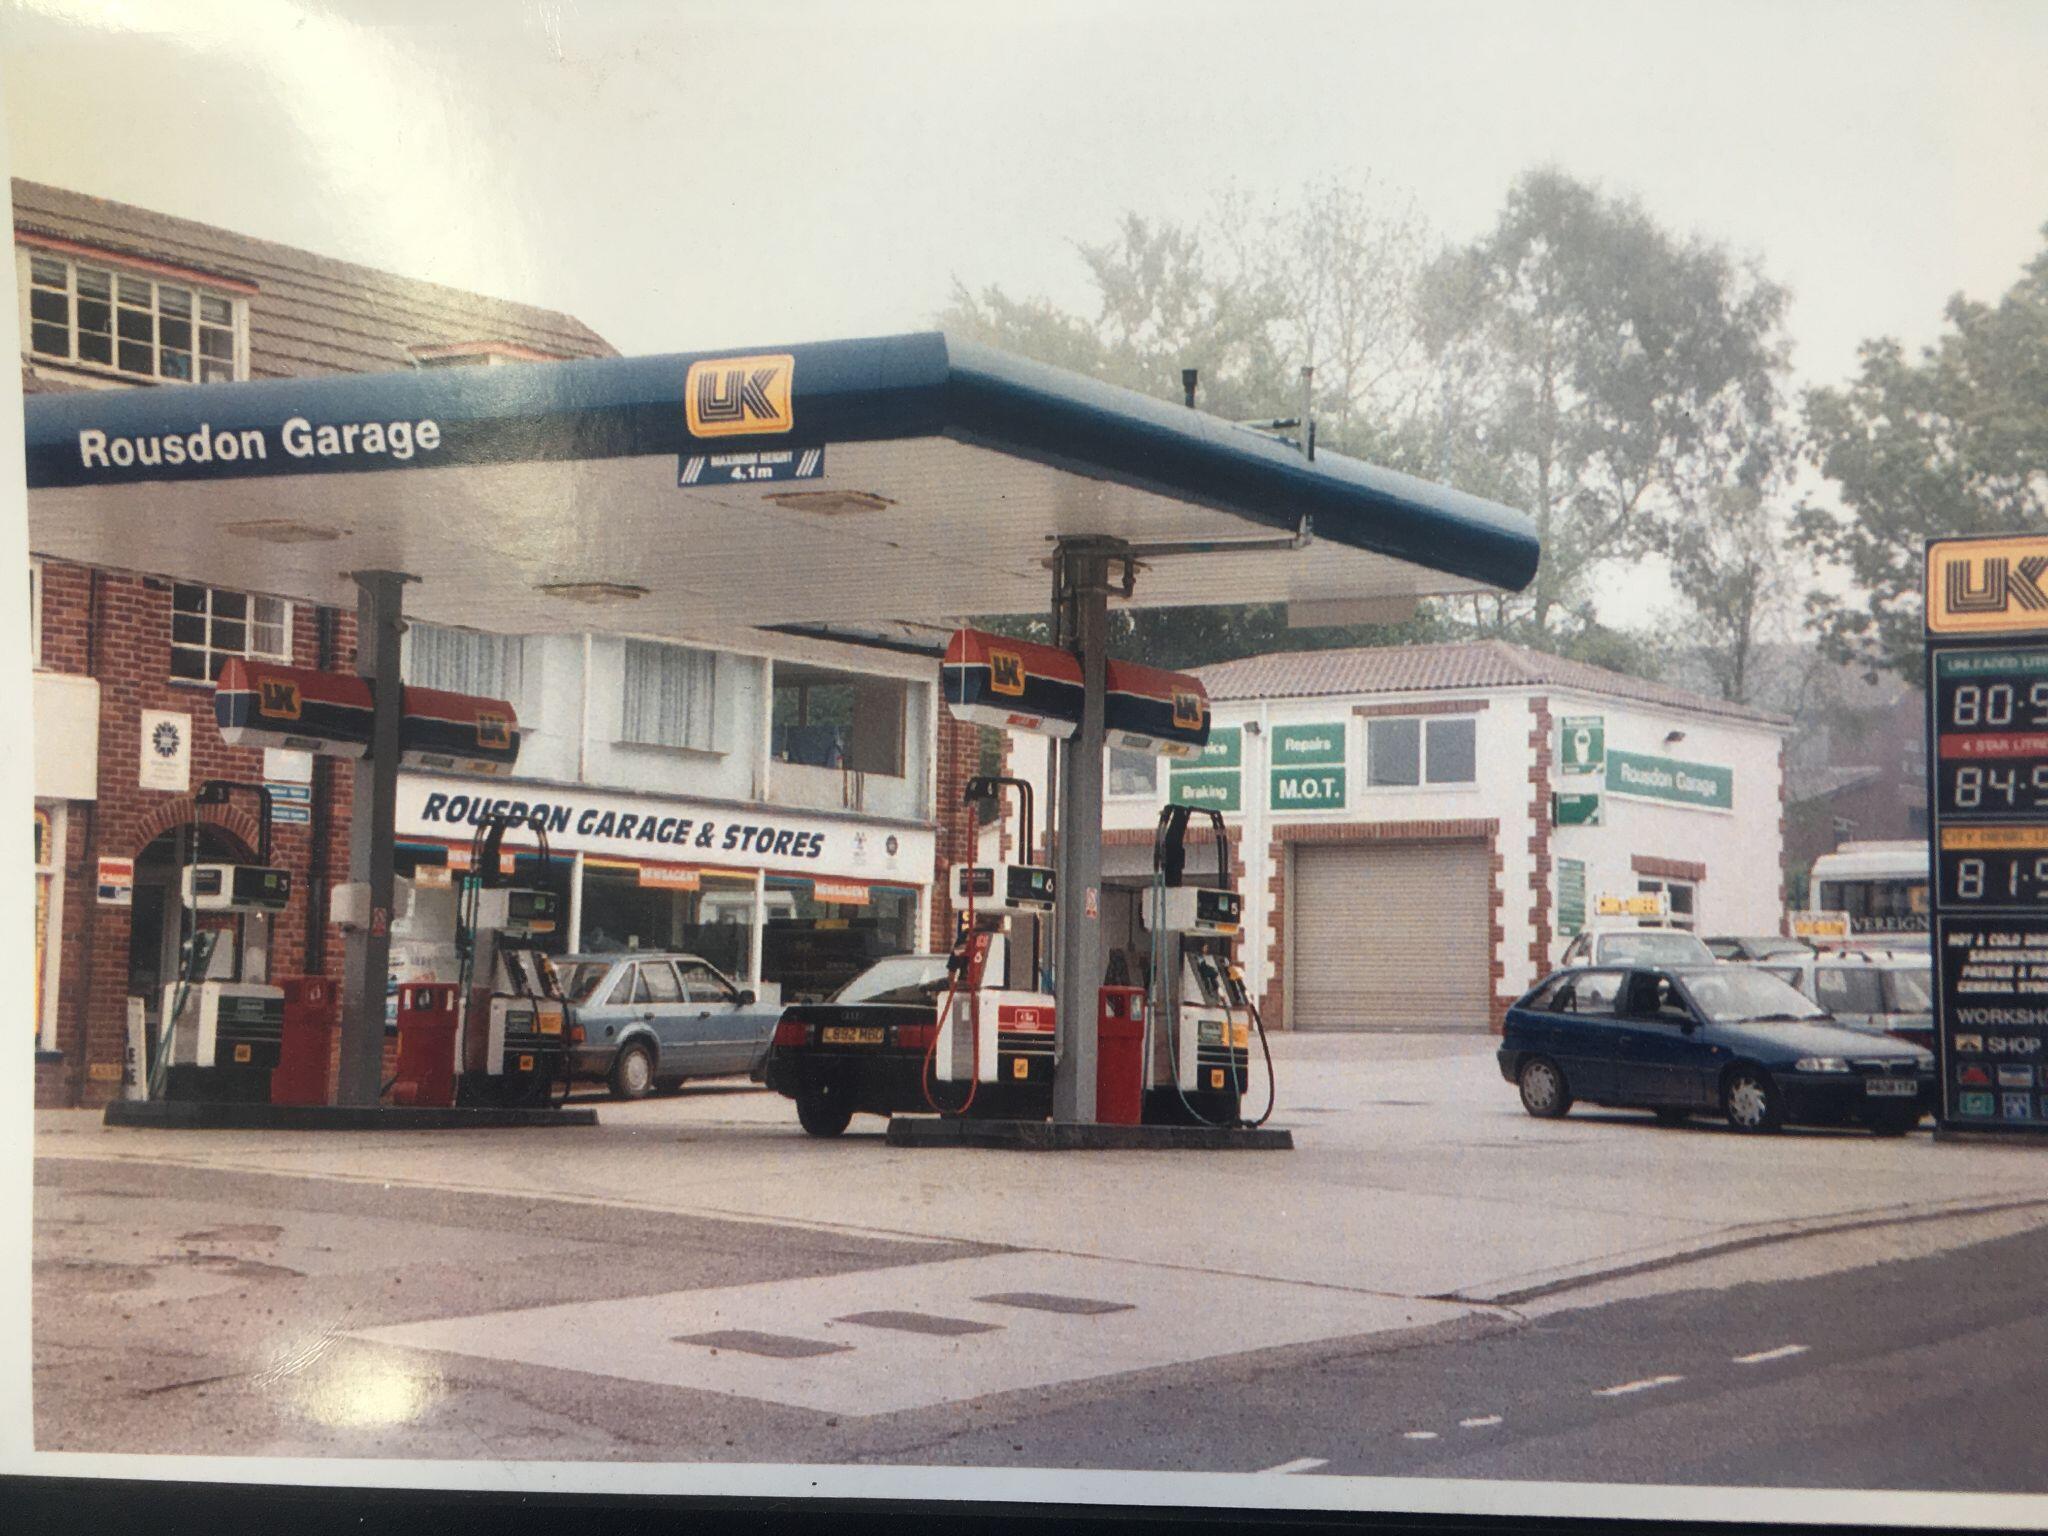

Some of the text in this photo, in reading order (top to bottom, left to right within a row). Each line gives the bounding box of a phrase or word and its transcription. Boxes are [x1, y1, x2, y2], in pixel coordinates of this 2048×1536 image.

[698, 367, 781, 424] UK
[79, 417, 442, 468] Rousdon Garage
[1946, 556, 2048, 614] UK
[1286, 736, 1332, 753] Repairs
[1182, 785, 1228, 800] Braking
[1280, 777, 1341, 799] M.O.T.
[1620, 762, 1718, 798] Rousdon Garage
[422, 792, 573, 835] ROUSDON
[577, 809, 694, 846] GARAGE
[695, 821, 715, 849] &
[721, 823, 826, 859] STORES
[1852, 917, 1930, 933] VEREIGN
[1987, 1036, 2042, 1054] SHOP
